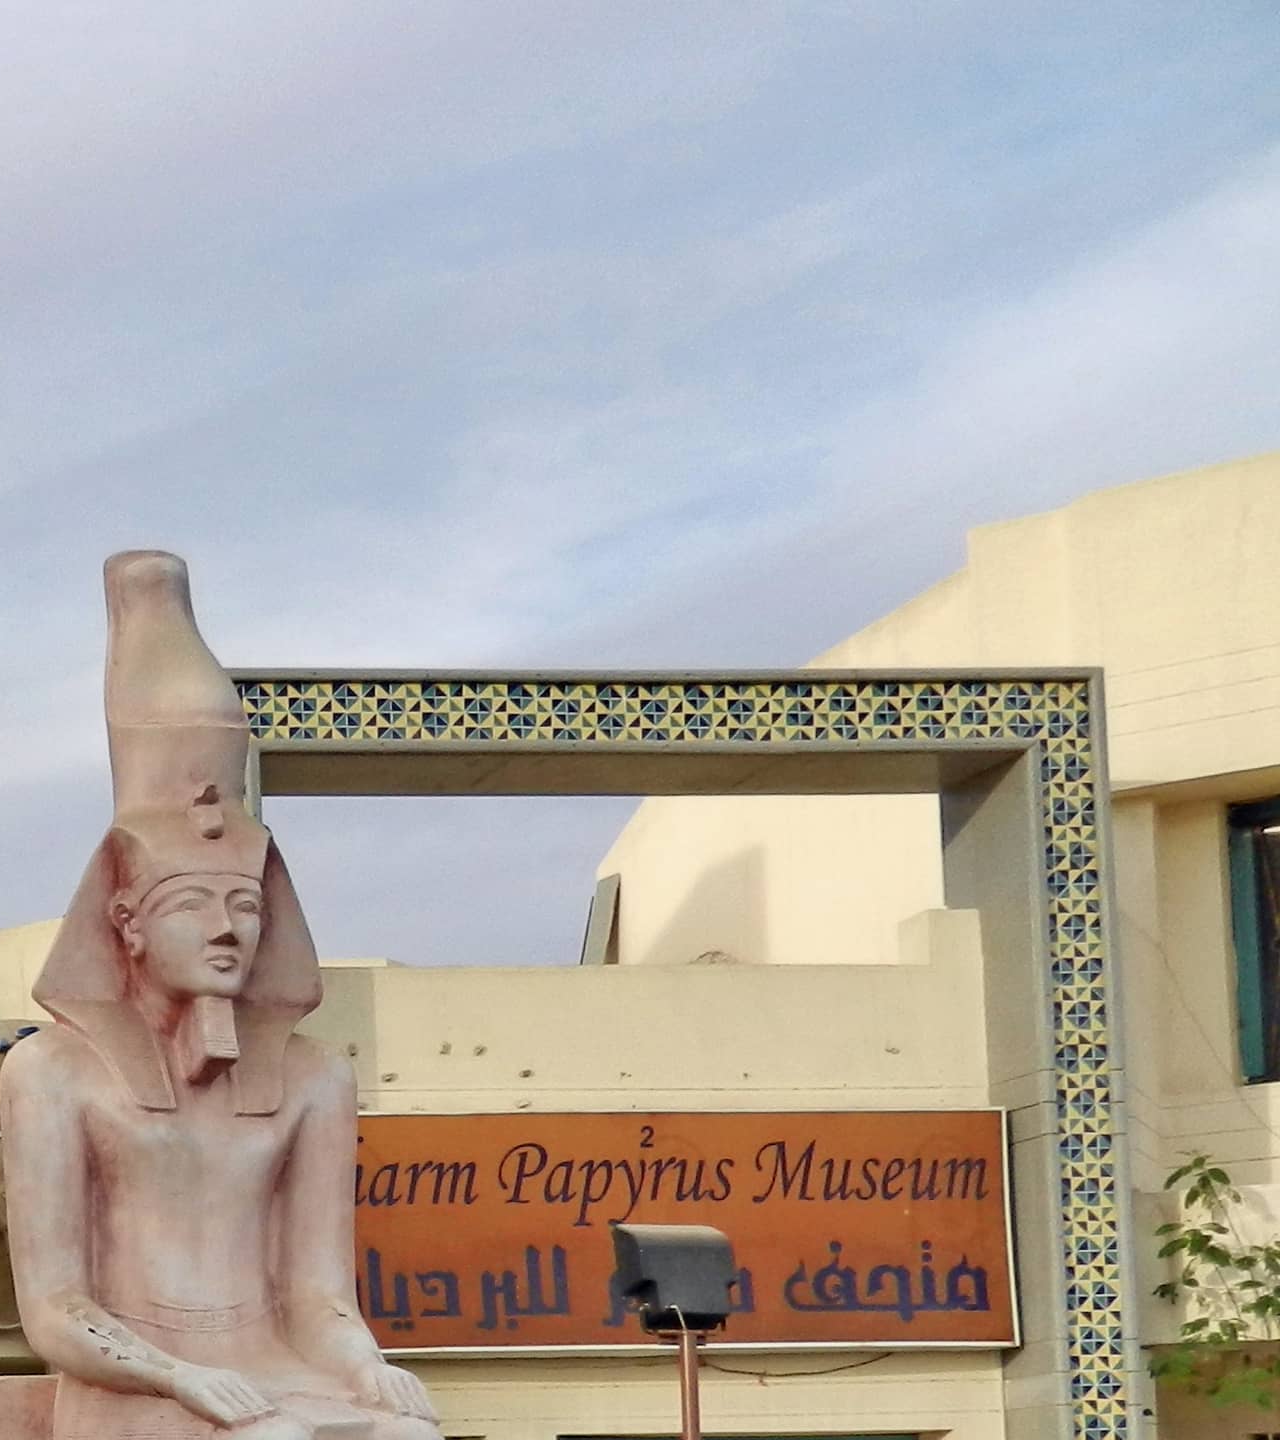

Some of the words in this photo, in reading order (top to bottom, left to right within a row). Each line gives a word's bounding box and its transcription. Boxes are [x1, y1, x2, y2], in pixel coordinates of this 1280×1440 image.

[639, 1125, 655, 1148] 2
[498, 1142, 735, 1226] Papyrus
[753, 1139, 989, 1204] Museum
[357, 1244, 571, 1331] للبرديا
